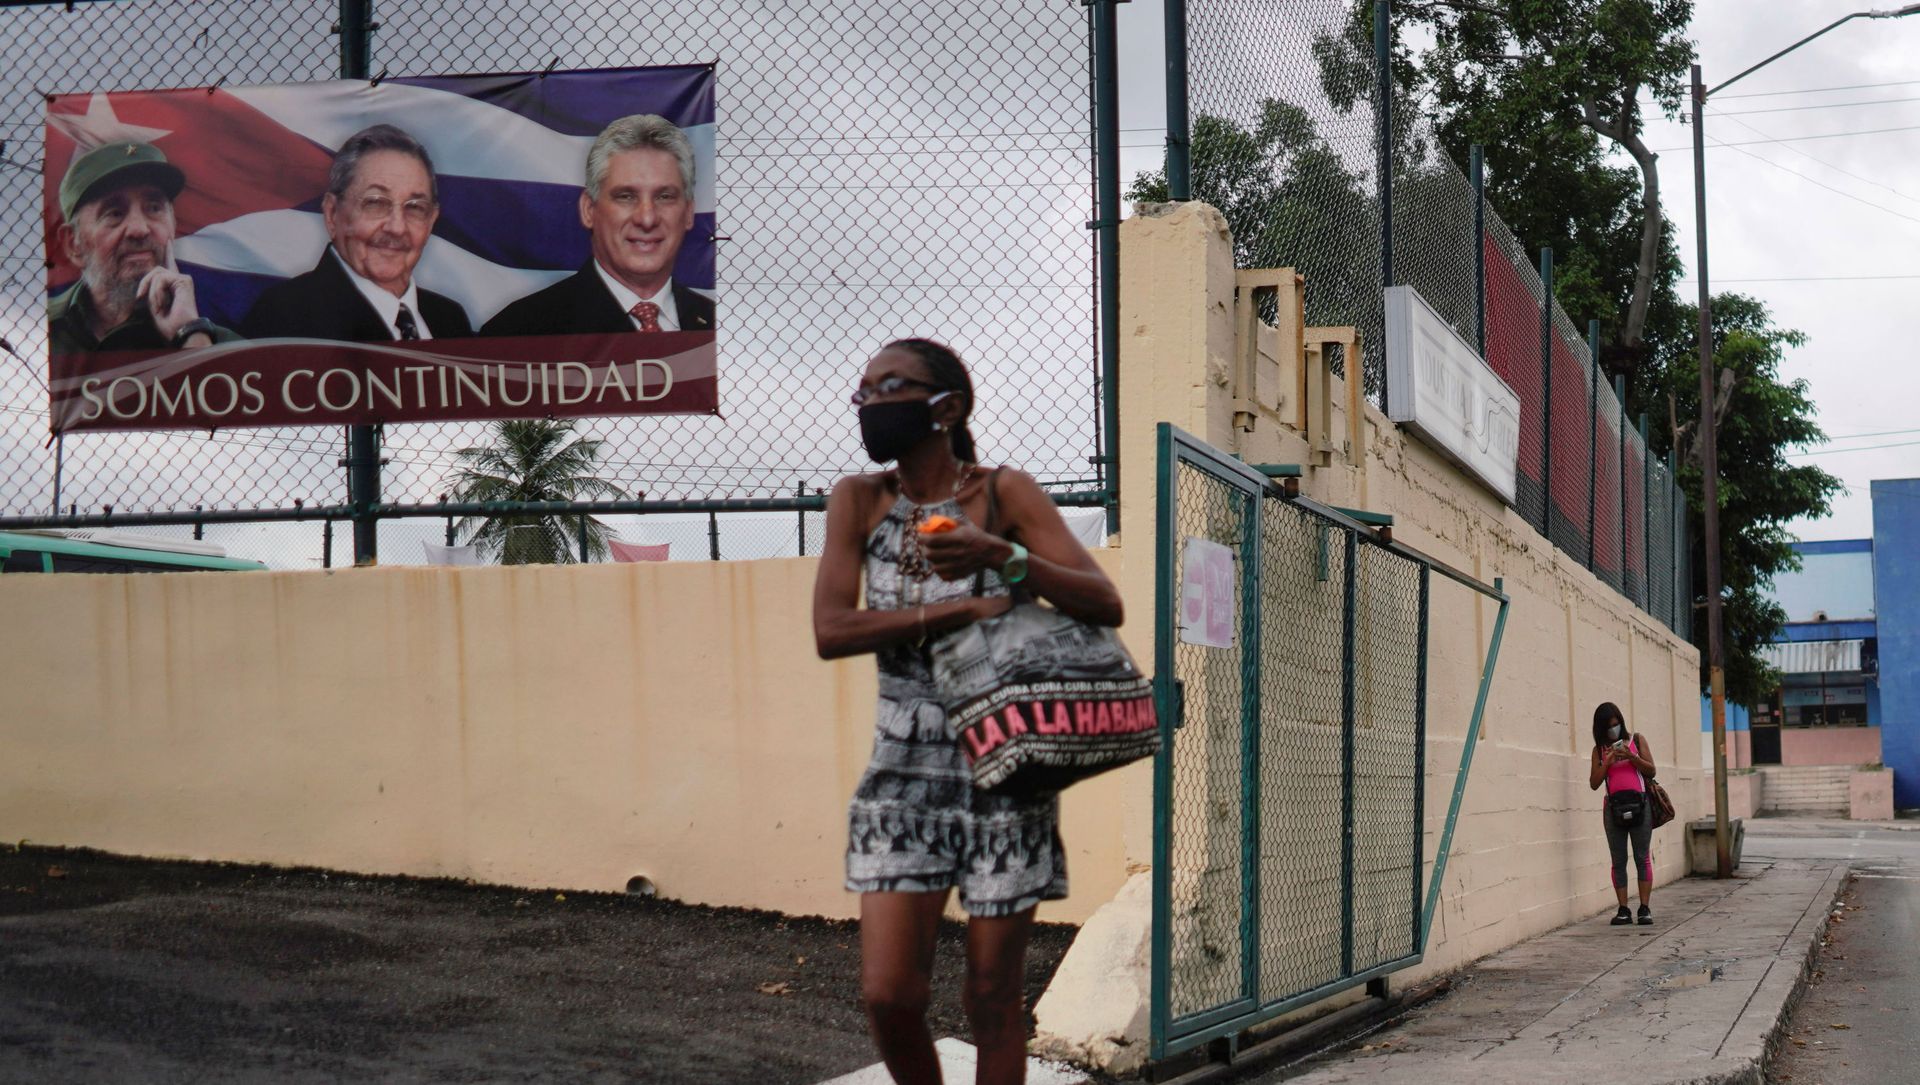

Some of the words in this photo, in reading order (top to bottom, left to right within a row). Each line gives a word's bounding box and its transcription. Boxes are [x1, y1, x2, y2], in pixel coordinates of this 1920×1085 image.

[81, 371, 265, 420] SOMOS
[282, 358, 674, 411] CONTINUIDAD
[1030, 681, 1063, 694] CUBA
[1063, 681, 1093, 692] CUBA
[965, 715, 1006, 757] LA
[1033, 701, 1072, 734] LA
[1075, 696, 1157, 735] HABANA
